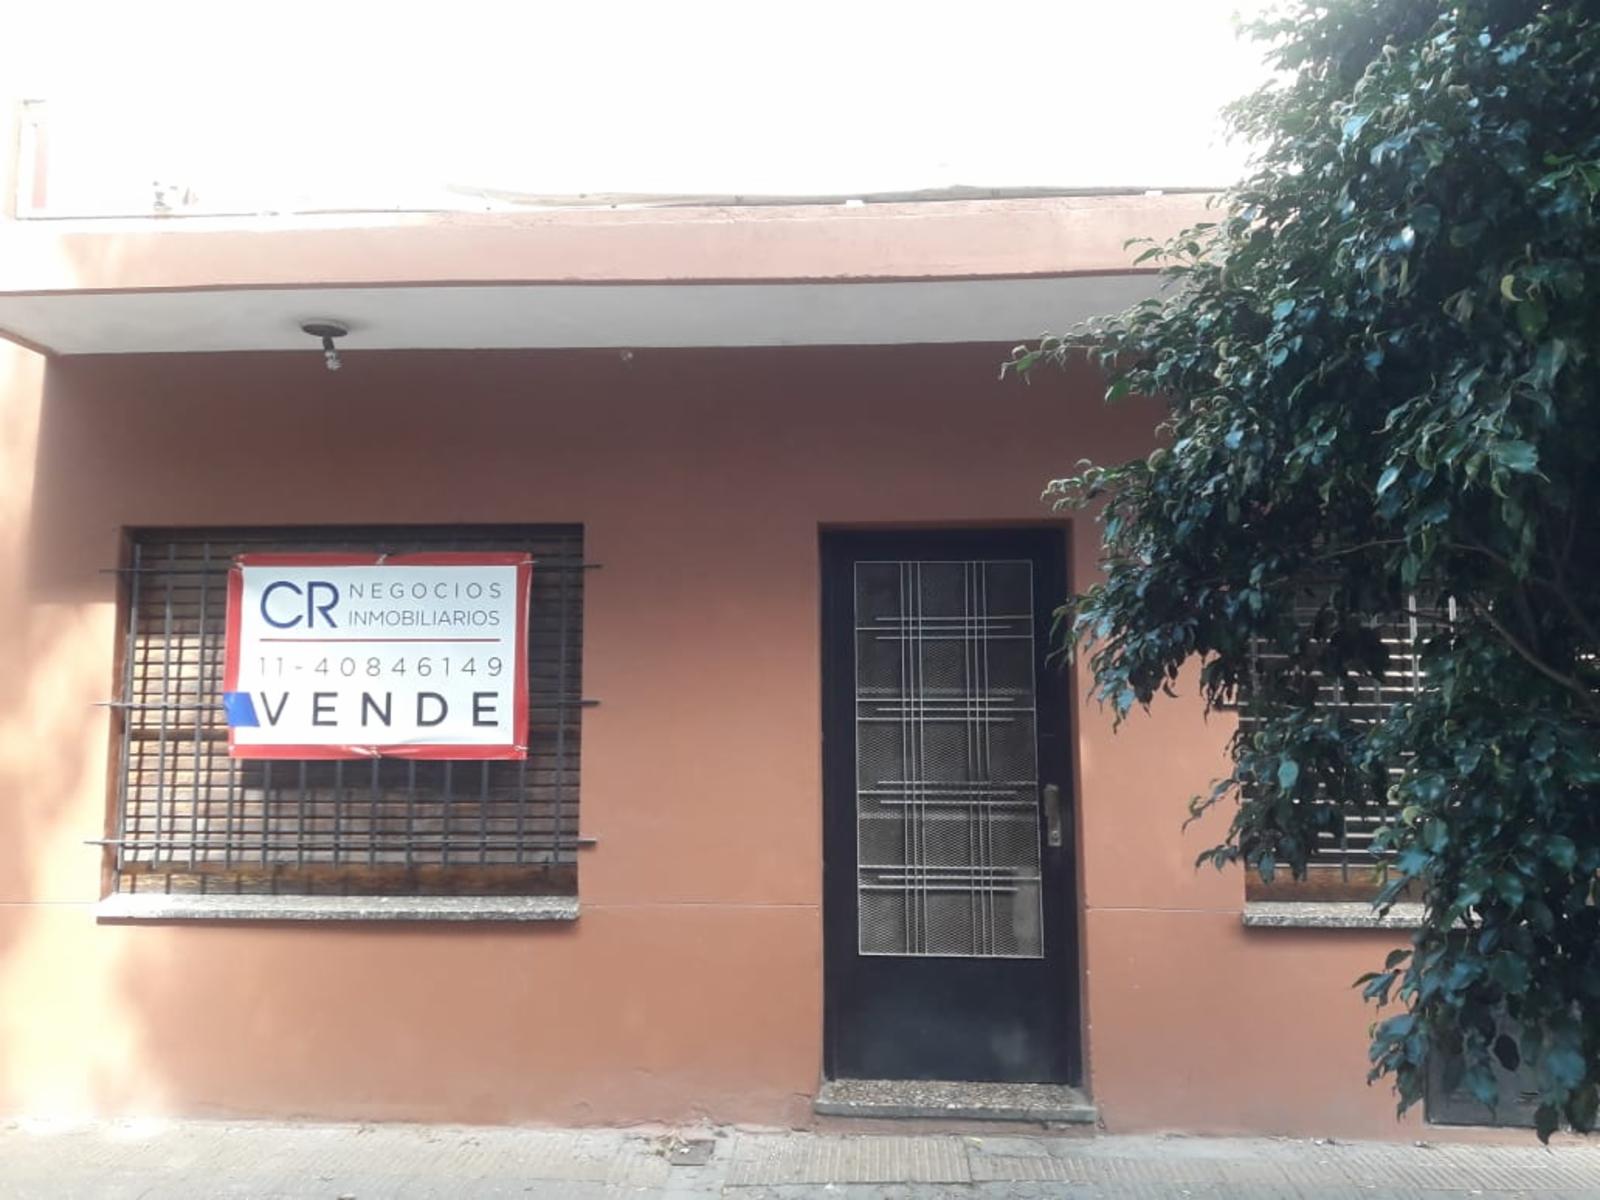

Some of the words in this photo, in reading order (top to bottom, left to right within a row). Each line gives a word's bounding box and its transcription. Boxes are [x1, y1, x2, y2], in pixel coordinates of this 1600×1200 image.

[260, 580, 340, 629] CR
[349, 582, 502, 600] NEGOCIOS
[348, 609, 500, 627] INMOBILIARIOS
[259, 691, 499, 728] VENDE
